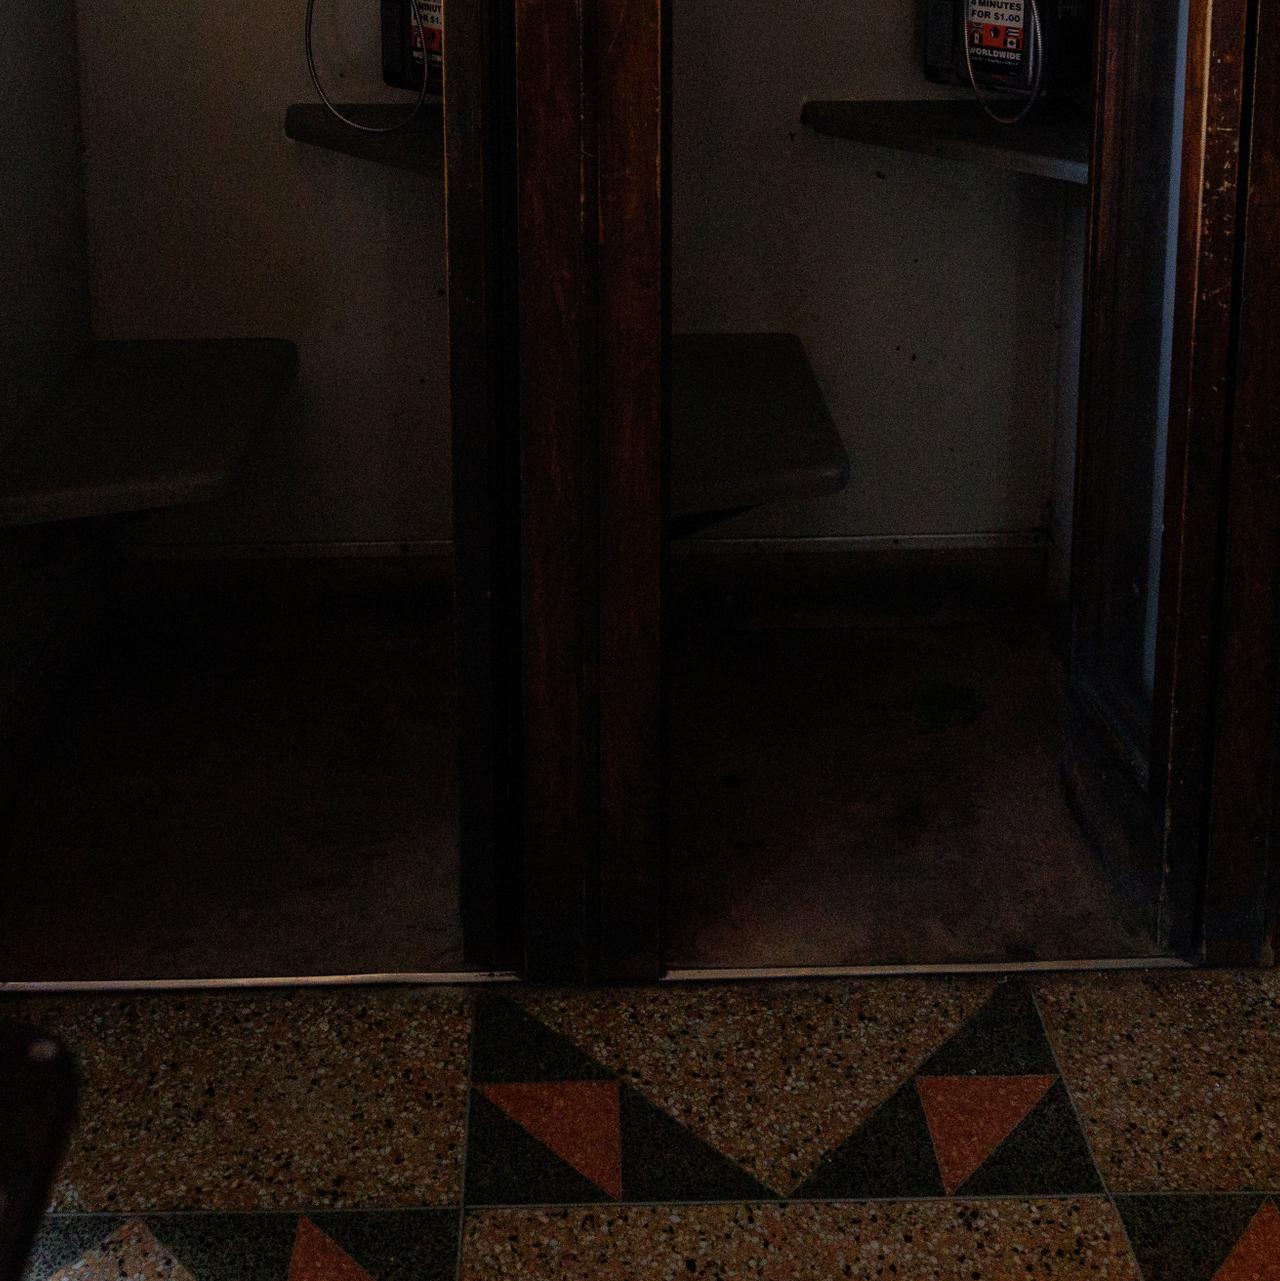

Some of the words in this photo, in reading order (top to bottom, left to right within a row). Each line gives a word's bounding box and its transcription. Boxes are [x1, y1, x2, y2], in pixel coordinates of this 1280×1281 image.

[978, 0, 1022, 11] MINUTES
[972, 10, 991, 19] FOR
[994, 12, 1020, 23] $1.00
[970, 47, 1022, 61] WORLDWIDE
